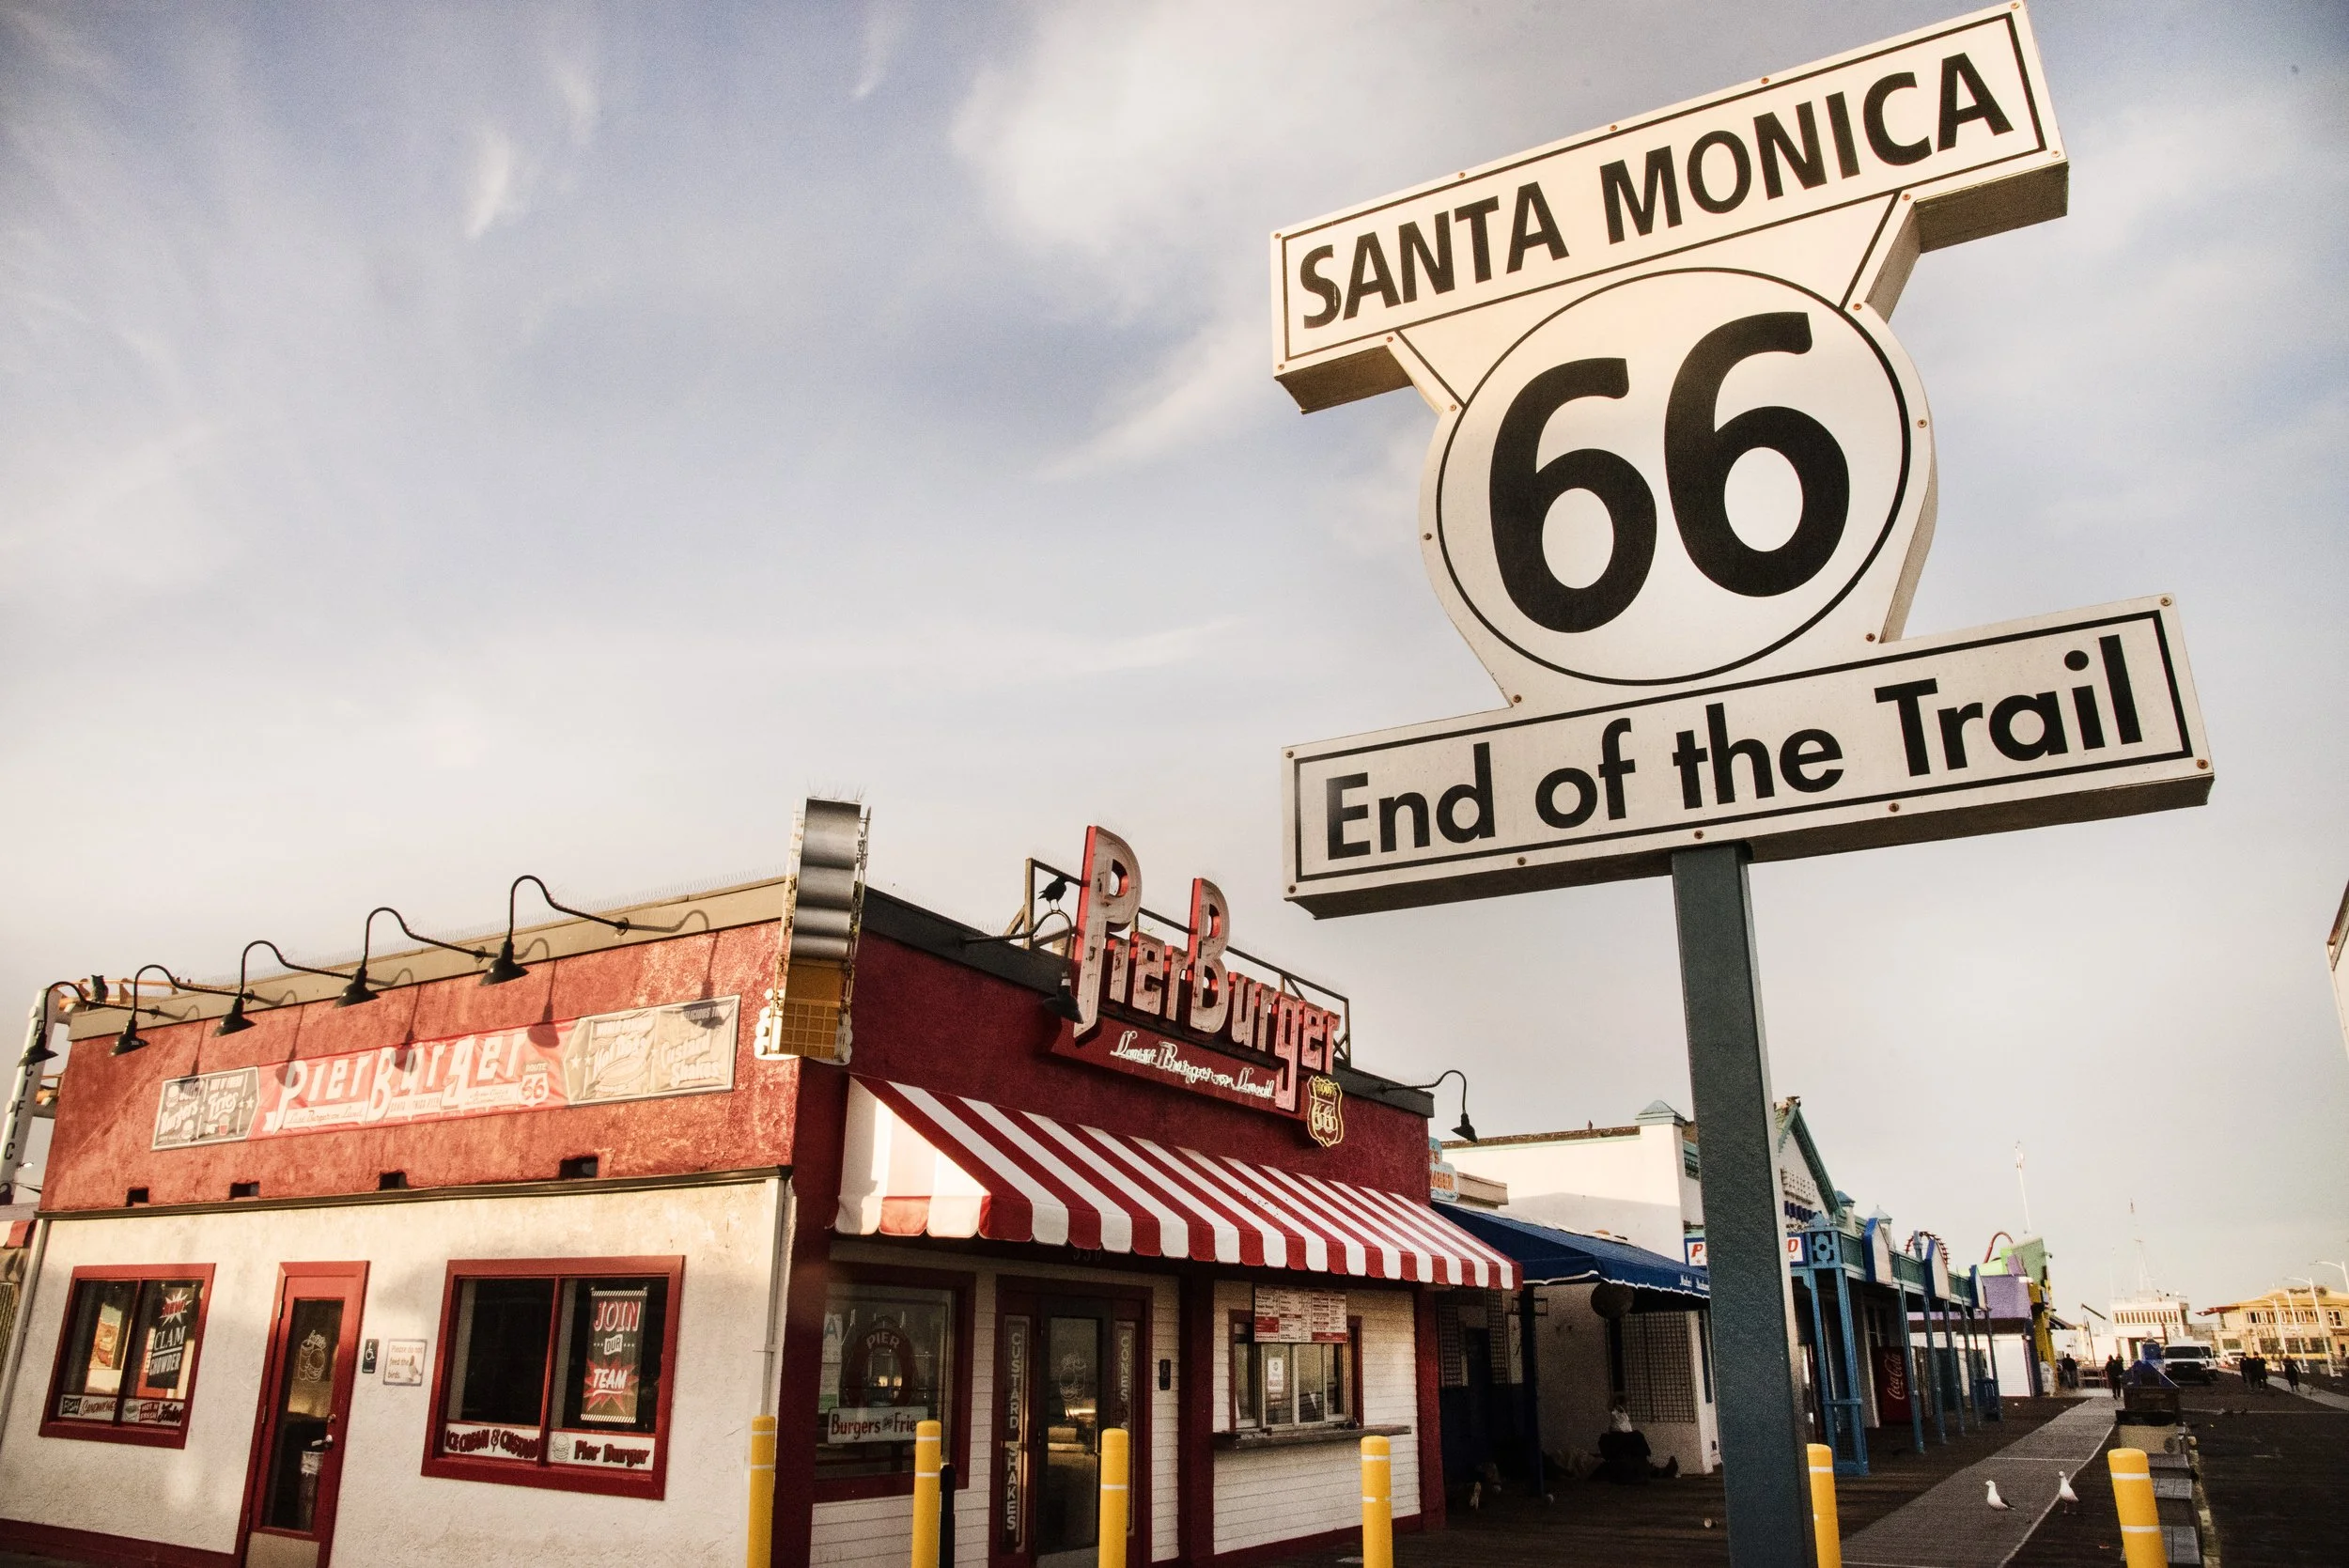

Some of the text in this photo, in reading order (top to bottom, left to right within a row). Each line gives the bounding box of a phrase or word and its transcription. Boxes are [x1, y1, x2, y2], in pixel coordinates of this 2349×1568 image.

[1300, 52, 2014, 327] SANTA MONICA
[1489, 311, 1849, 634] 66
[1325, 634, 2142, 862] End of the Trail
[661, 1029, 711, 1070] Custard
[670, 1059, 721, 1087] Shakes
[4, 1019, 46, 1161] PCIFIC
[521, 1079, 545, 1099] 66
[1313, 1102, 1338, 1134] 66
[593, 1301, 642, 1332] JOIN
[154, 1326, 186, 1351] CLAM
[391, 1345, 407, 1354] Please
[606, 1338, 621, 1350] OUR
[866, 1331, 900, 1350] PIER
[149, 1353, 181, 1375] CHOWDER
[1119, 1334, 1129, 1403] CONES
[593, 1368, 628, 1389] TEAM
[1008, 1334, 1021, 1430] CUSTARD
[832, 1413, 881, 1439] Burgers
[894, 1412, 917, 1433] Frie
[445, 1430, 459, 1452] ICE
[459, 1429, 489, 1453] CREAM
[574, 1439, 650, 1467] Pier Burger
[1005, 1442, 1019, 1531] SHAKES
